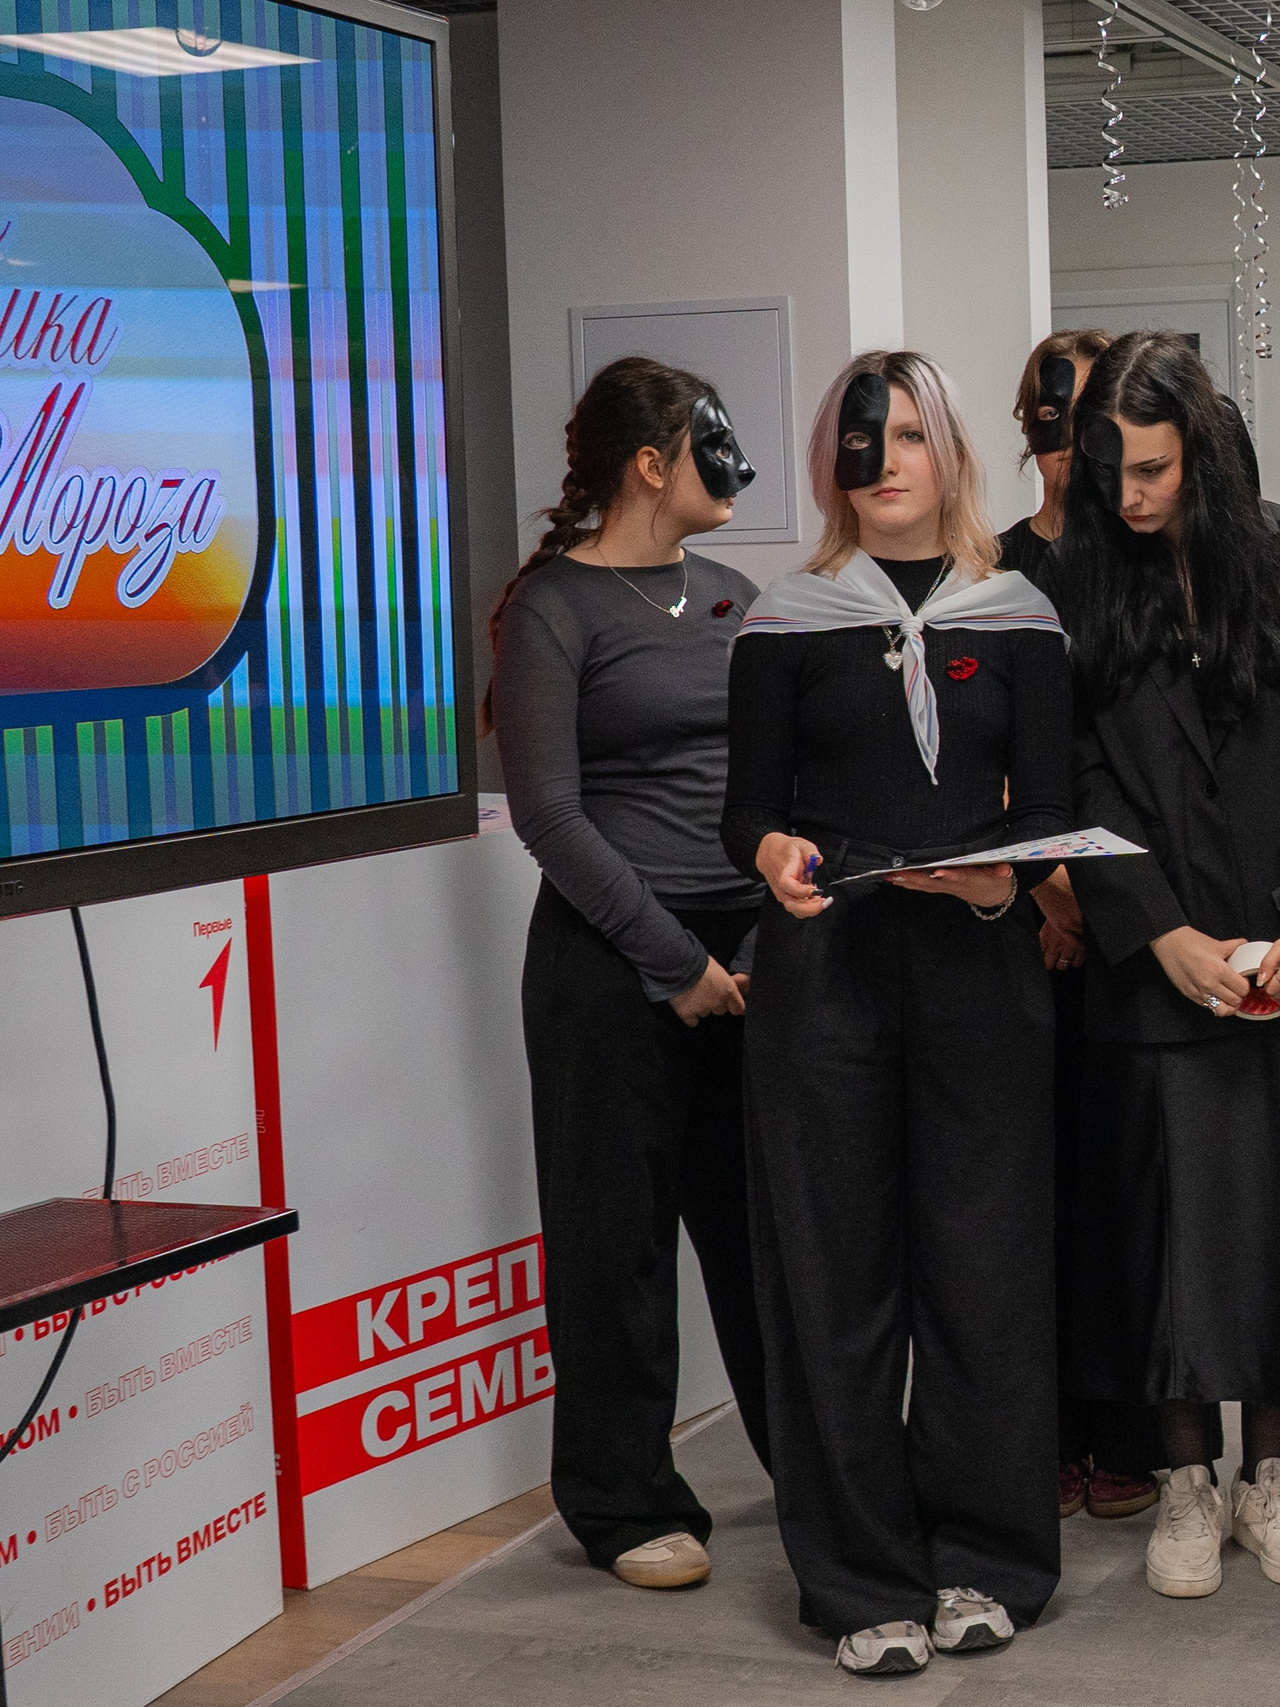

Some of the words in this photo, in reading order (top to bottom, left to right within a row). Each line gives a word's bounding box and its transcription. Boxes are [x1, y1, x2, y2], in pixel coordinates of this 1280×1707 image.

[193, 918, 233, 939] Первые
[156, 1132, 250, 1190] ВМЕСТЕ
[357, 1242, 541, 1362] КРЕП
[85, 1365, 156, 1418] БЫТЬ
[160, 1315, 253, 1381] ВМЕСТЕ
[361, 1339, 556, 1458] СЕМЬ
[44, 1484, 118, 1543] БЫТЬ
[122, 1468, 141, 1499] С
[144, 1402, 254, 1488] РОССИЕЙ
[104, 1551, 172, 1608] БЫТЬ
[176, 1491, 267, 1565] ВМЕСТЕ
